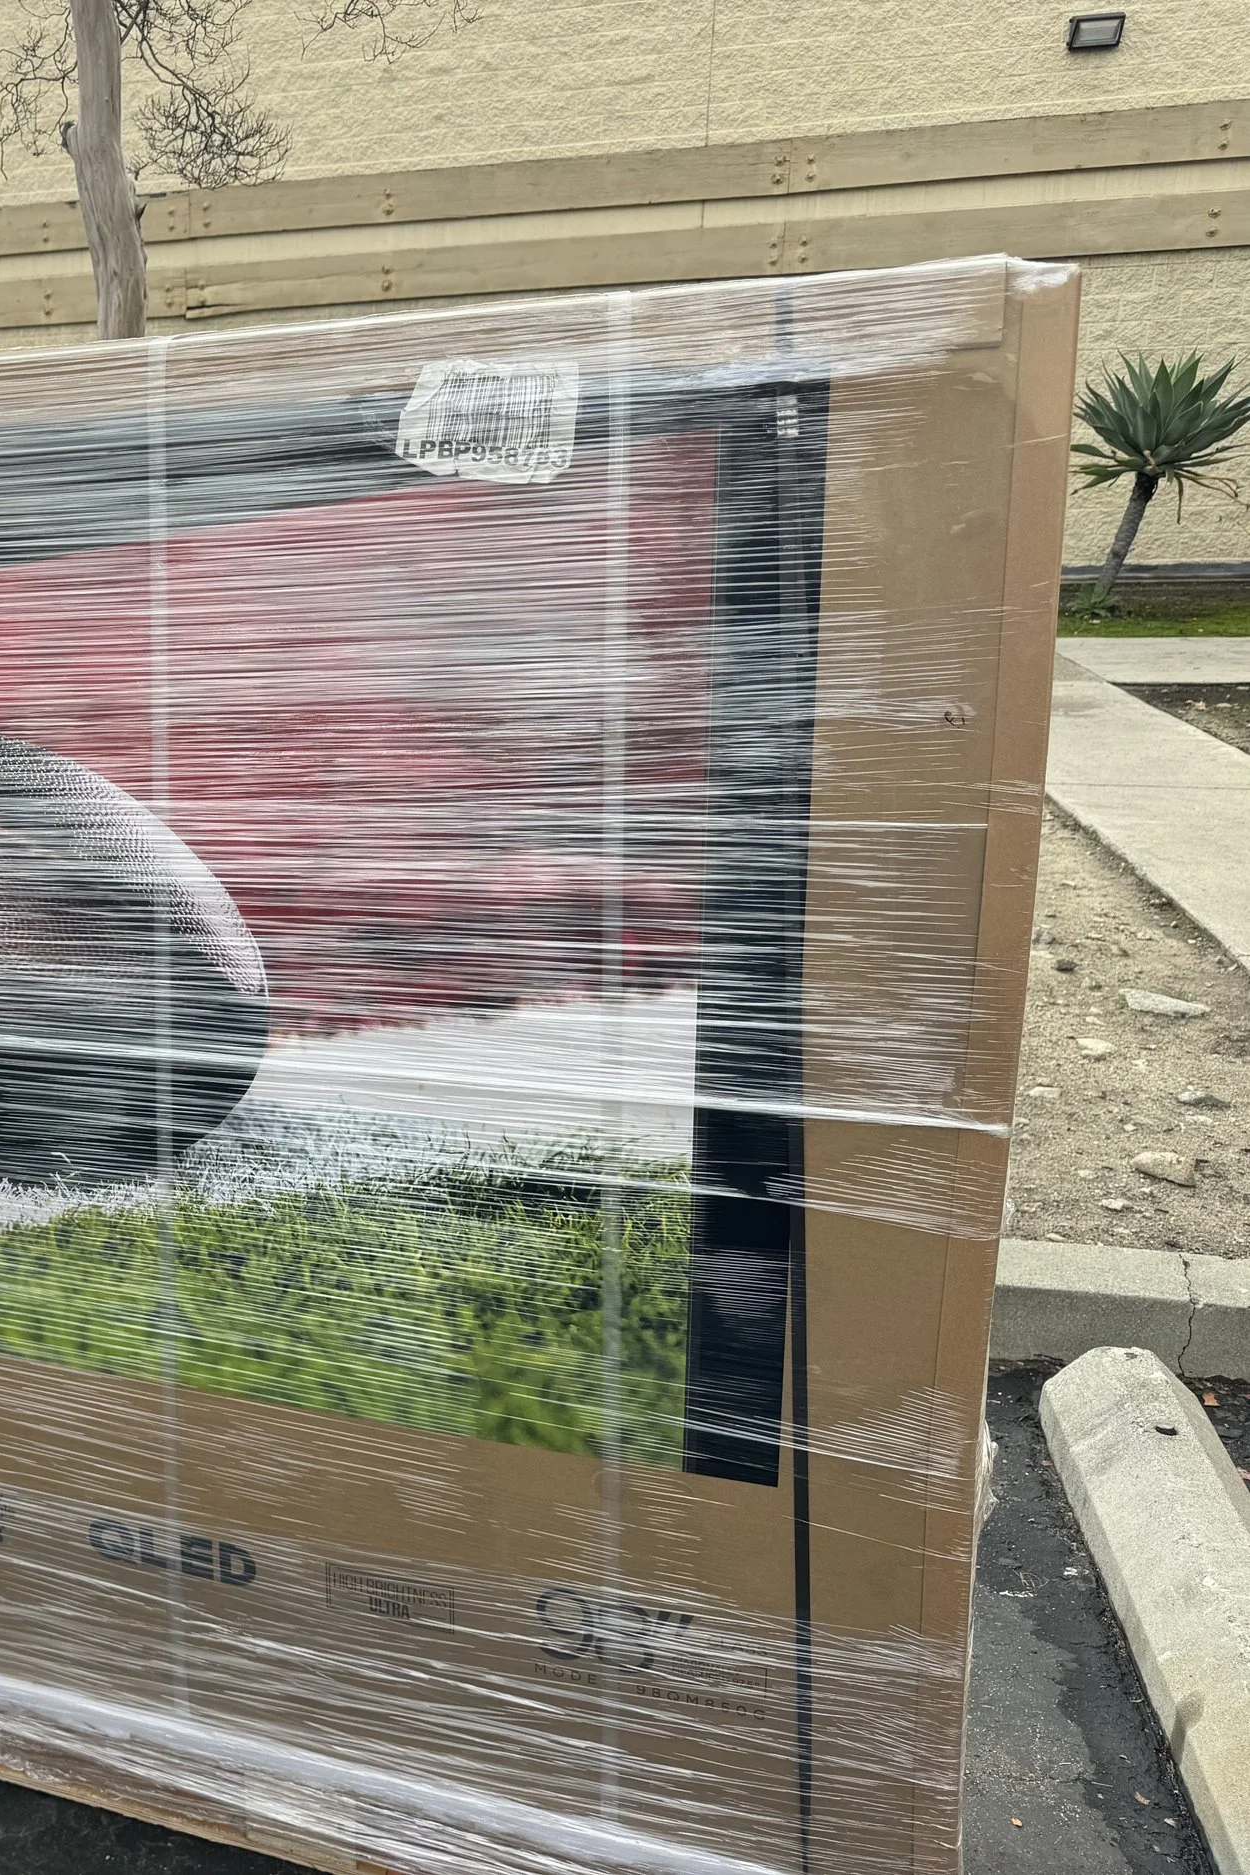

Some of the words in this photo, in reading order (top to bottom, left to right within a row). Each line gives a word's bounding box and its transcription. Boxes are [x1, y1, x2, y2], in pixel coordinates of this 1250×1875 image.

[88, 1516, 258, 1587] QLED
[332, 1572, 363, 1592] HIGH
[366, 1578, 447, 1608] BRIGHTNESS
[369, 1595, 410, 1618] ULTRA
